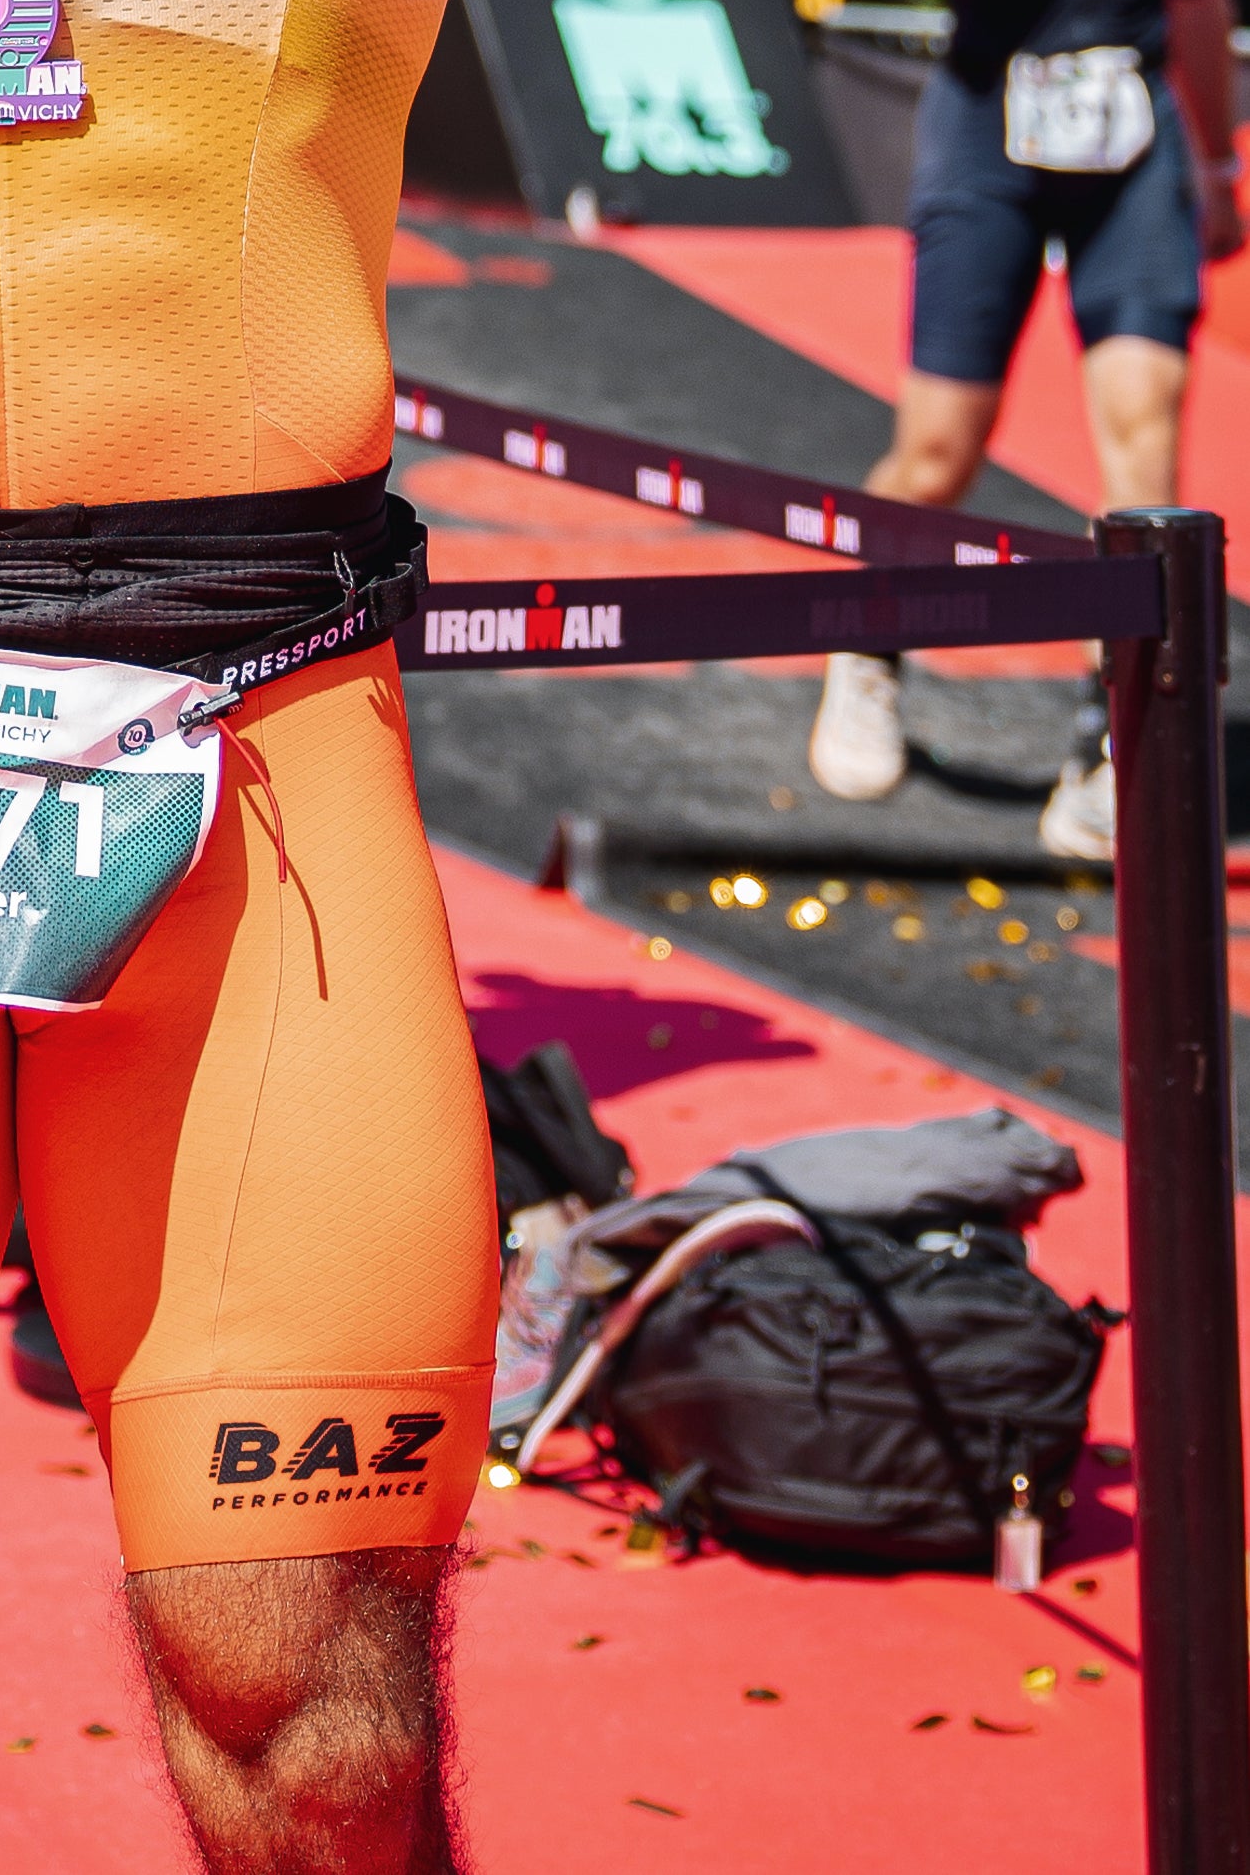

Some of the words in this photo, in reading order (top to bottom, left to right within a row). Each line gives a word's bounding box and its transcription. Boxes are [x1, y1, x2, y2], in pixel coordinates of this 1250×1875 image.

[18, 101, 81, 121] VICHY
[221, 608, 368, 687] PRESSPORT
[424, 582, 622, 654] IRONMAN
[209, 1411, 445, 1485] BAZ
[212, 1481, 428, 1511] PERFORMANCE
